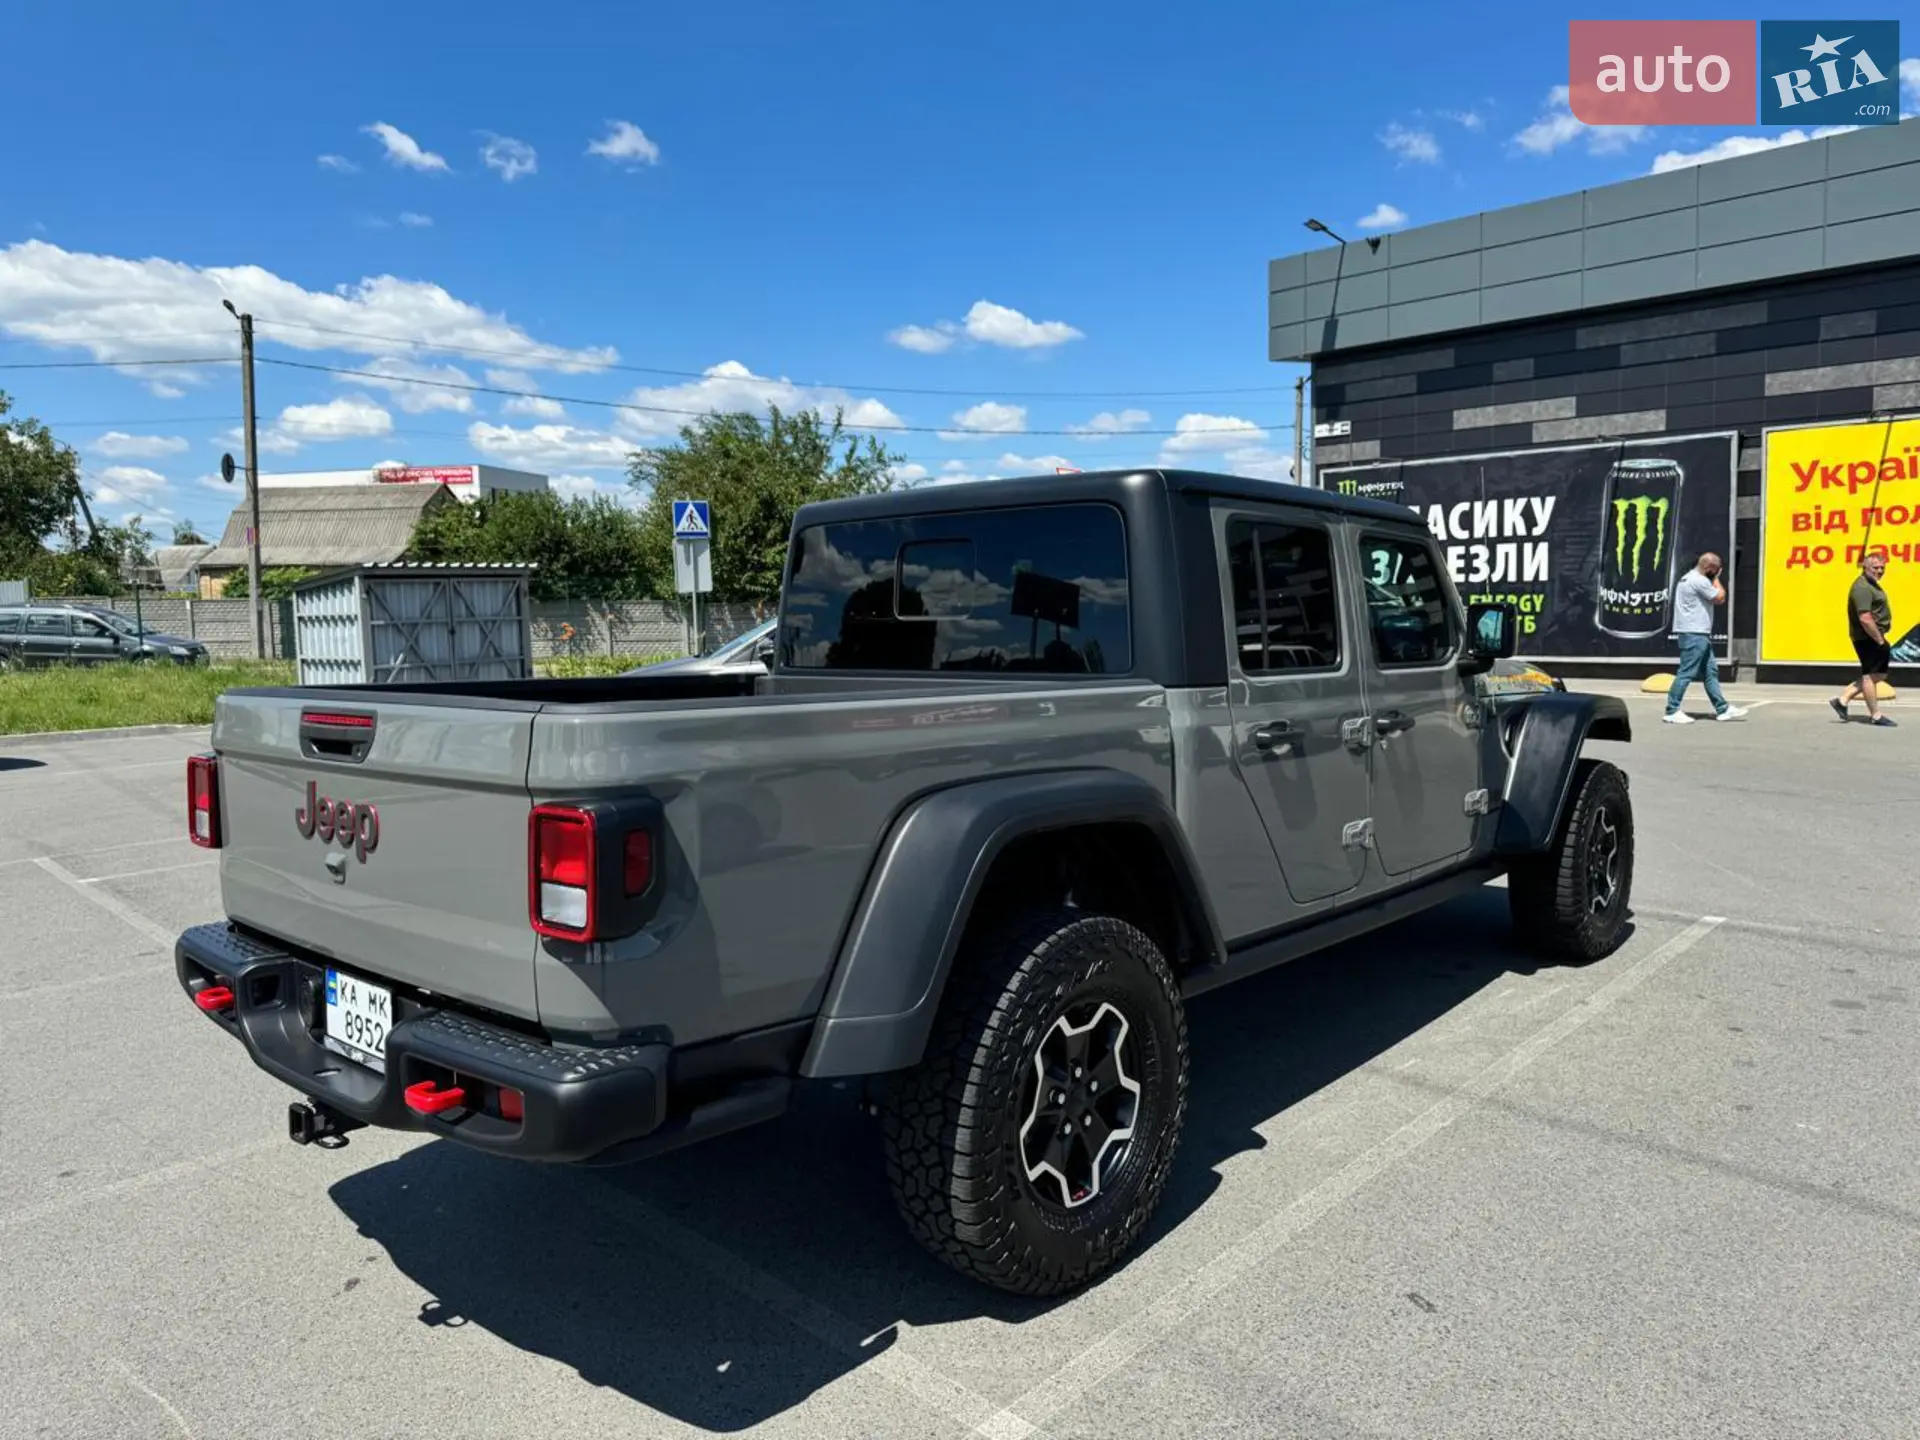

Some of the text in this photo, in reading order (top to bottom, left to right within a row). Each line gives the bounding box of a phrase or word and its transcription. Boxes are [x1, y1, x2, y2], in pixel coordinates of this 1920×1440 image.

[1408, 496, 1556, 541] АСИКУ
[1792, 504, 1849, 534] від
[1786, 543, 1920, 569] до пач
[296, 780, 379, 865] Jeep
[340, 979, 387, 1019] KA MK
[345, 1010, 385, 1054] 8952
